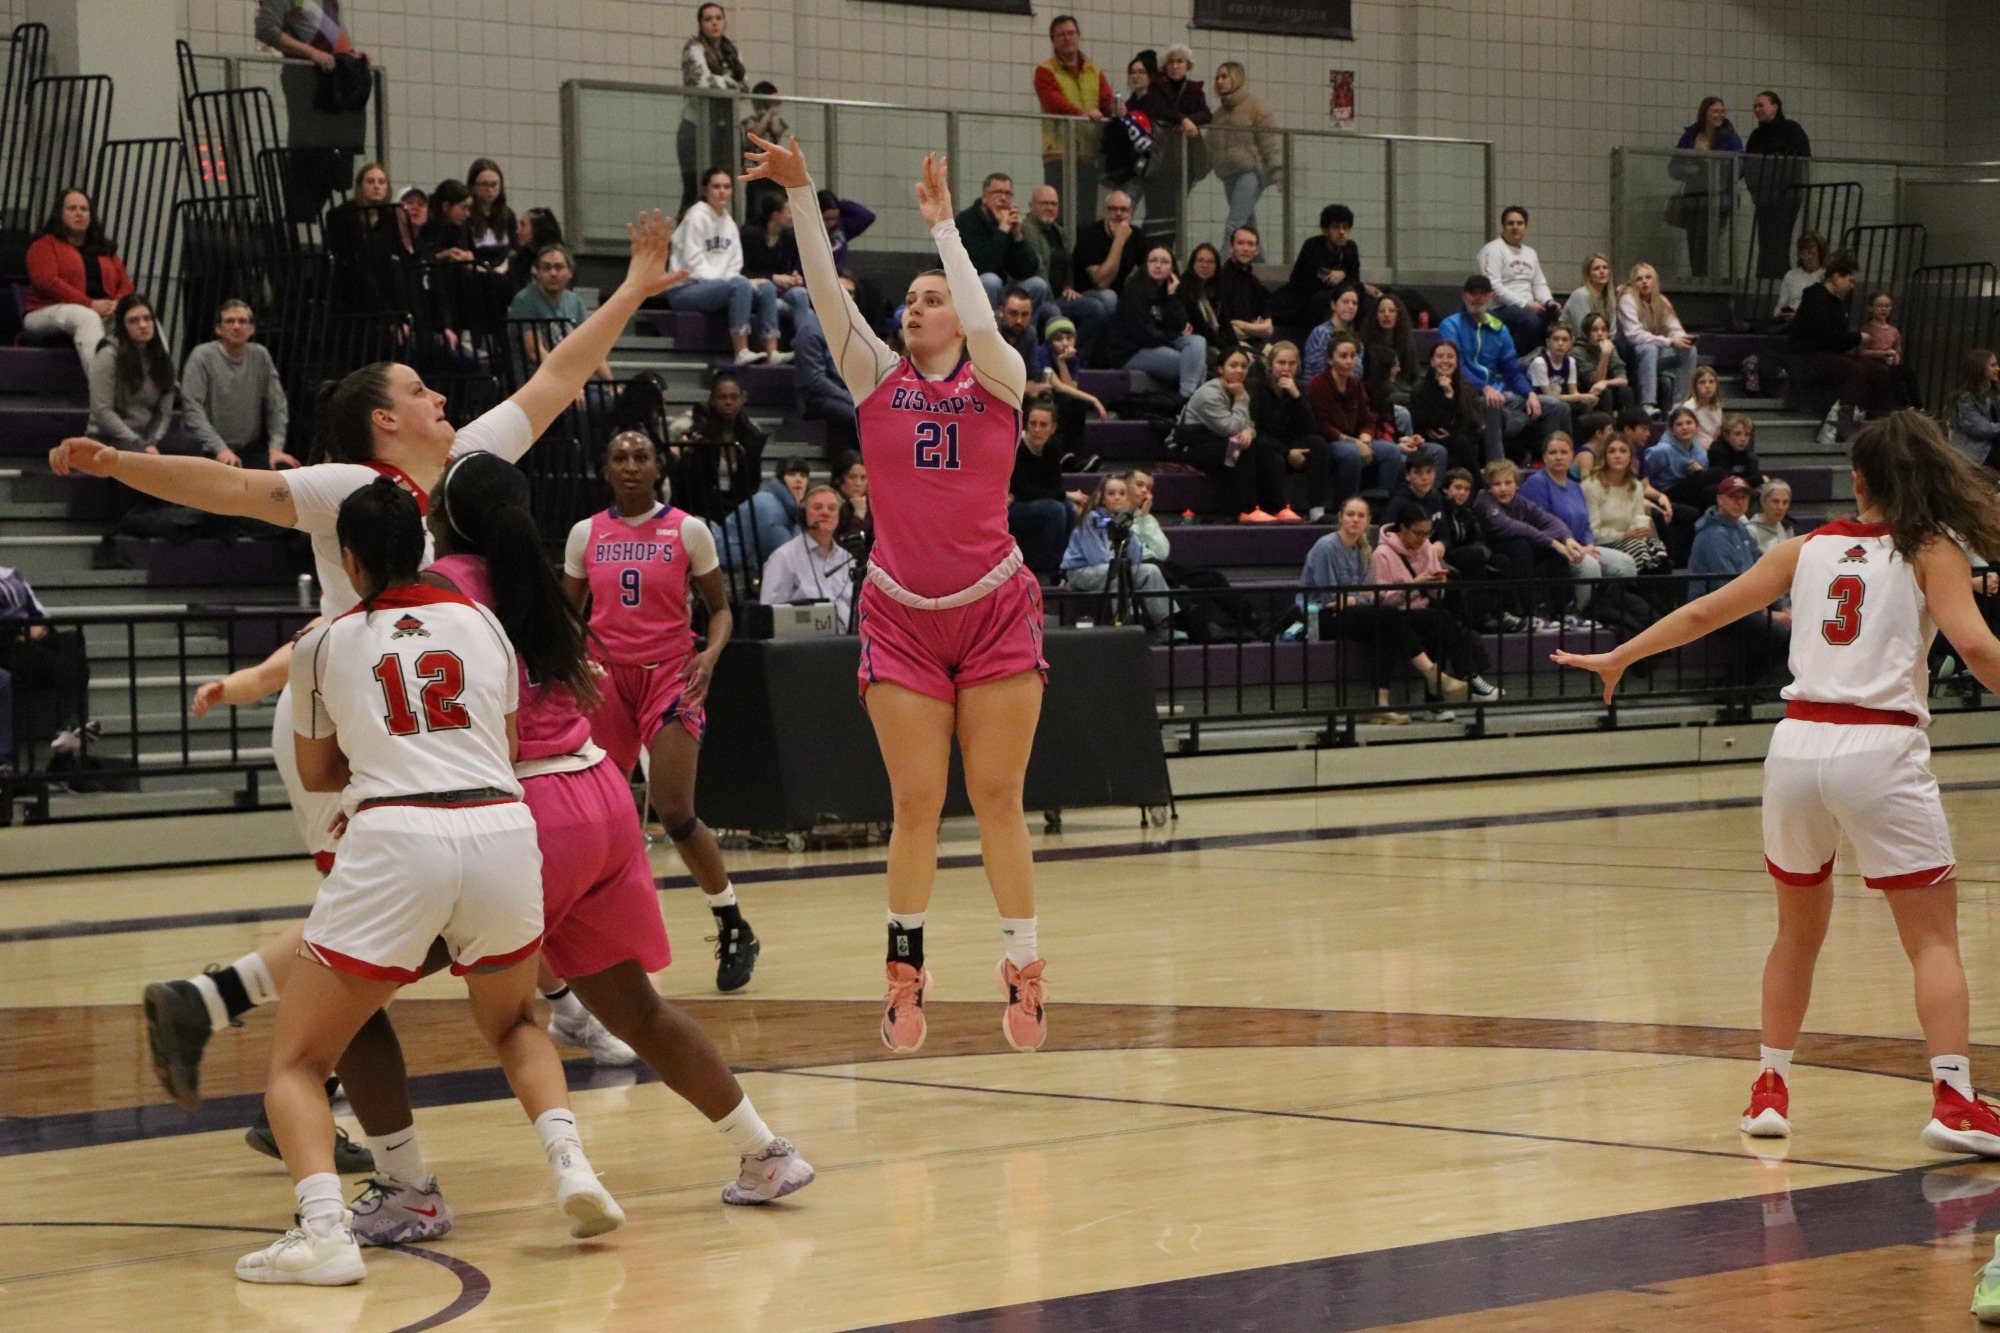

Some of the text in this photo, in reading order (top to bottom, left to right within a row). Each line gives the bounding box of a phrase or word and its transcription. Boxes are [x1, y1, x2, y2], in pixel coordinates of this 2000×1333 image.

[891, 387, 986, 414] BISHOP'S
[914, 420, 960, 470] 21
[595, 542, 673, 563] BISHOP'S
[620, 567, 641, 608] 9
[1822, 574, 1865, 645] 3
[372, 650, 471, 736] 12
